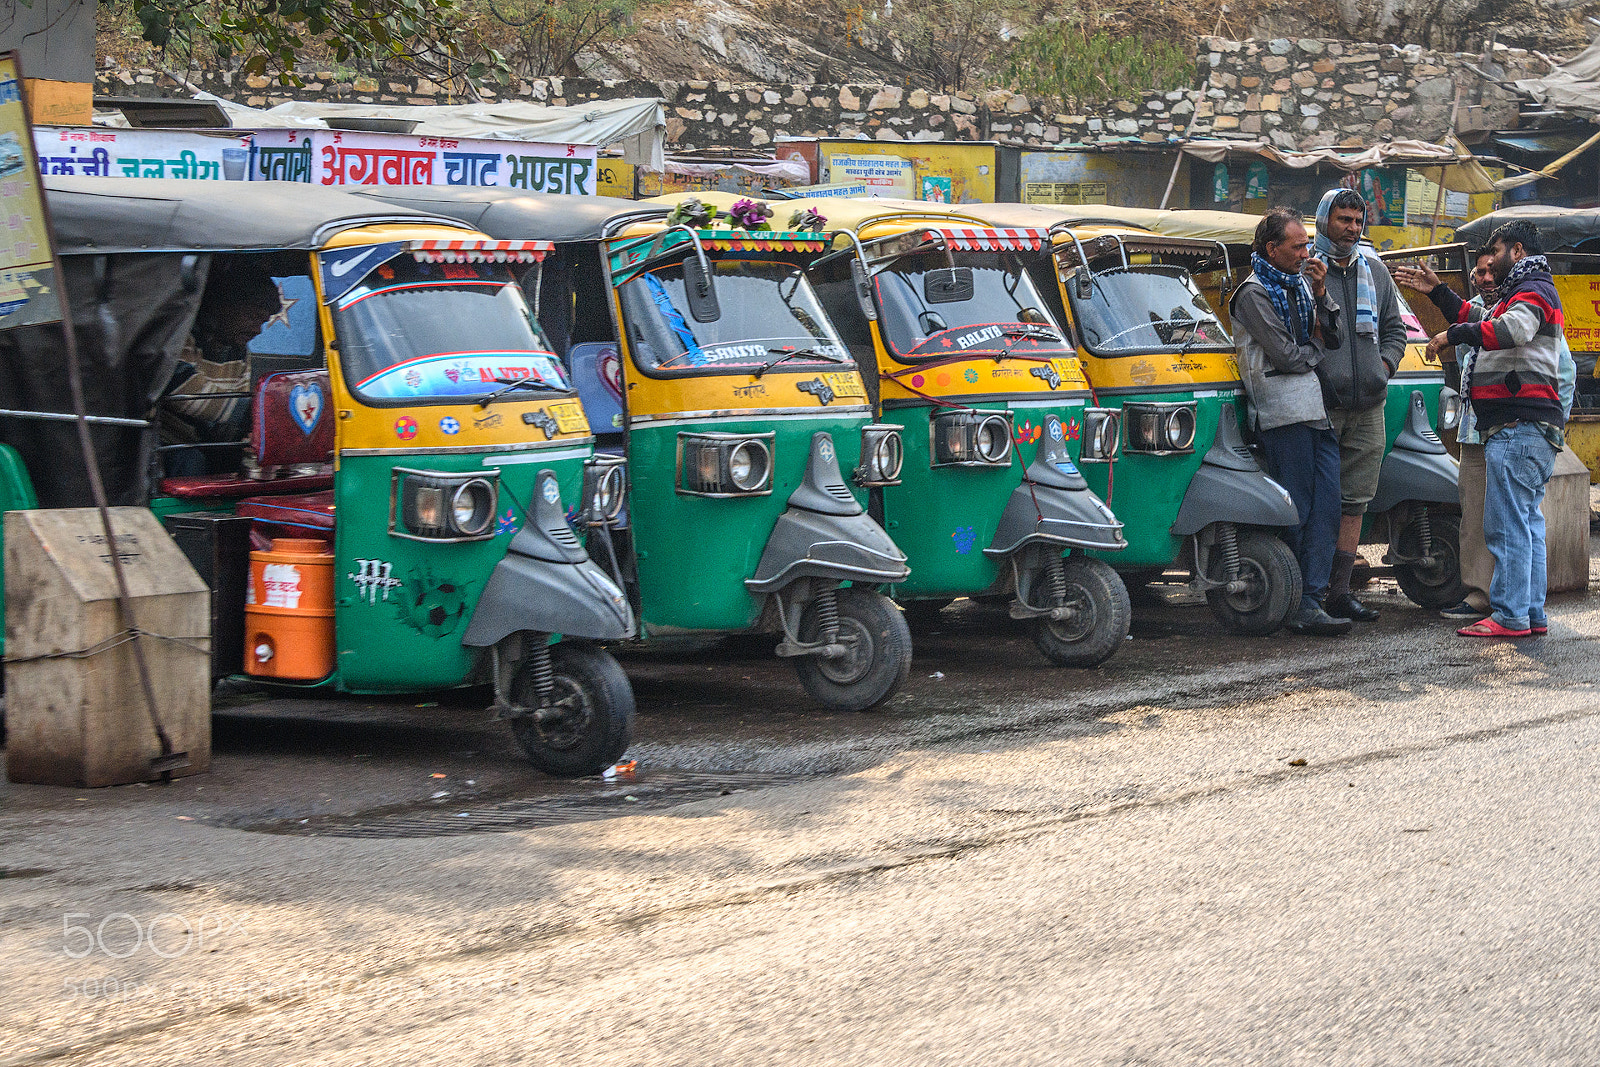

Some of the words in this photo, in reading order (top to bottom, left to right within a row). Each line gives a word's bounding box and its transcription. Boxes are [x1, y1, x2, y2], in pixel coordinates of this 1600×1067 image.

[321, 145, 437, 185] अग्रवाल
[443, 152, 502, 186] चाट
[507, 154, 592, 195] भण्डार
[703, 344, 768, 362] SANIYA
